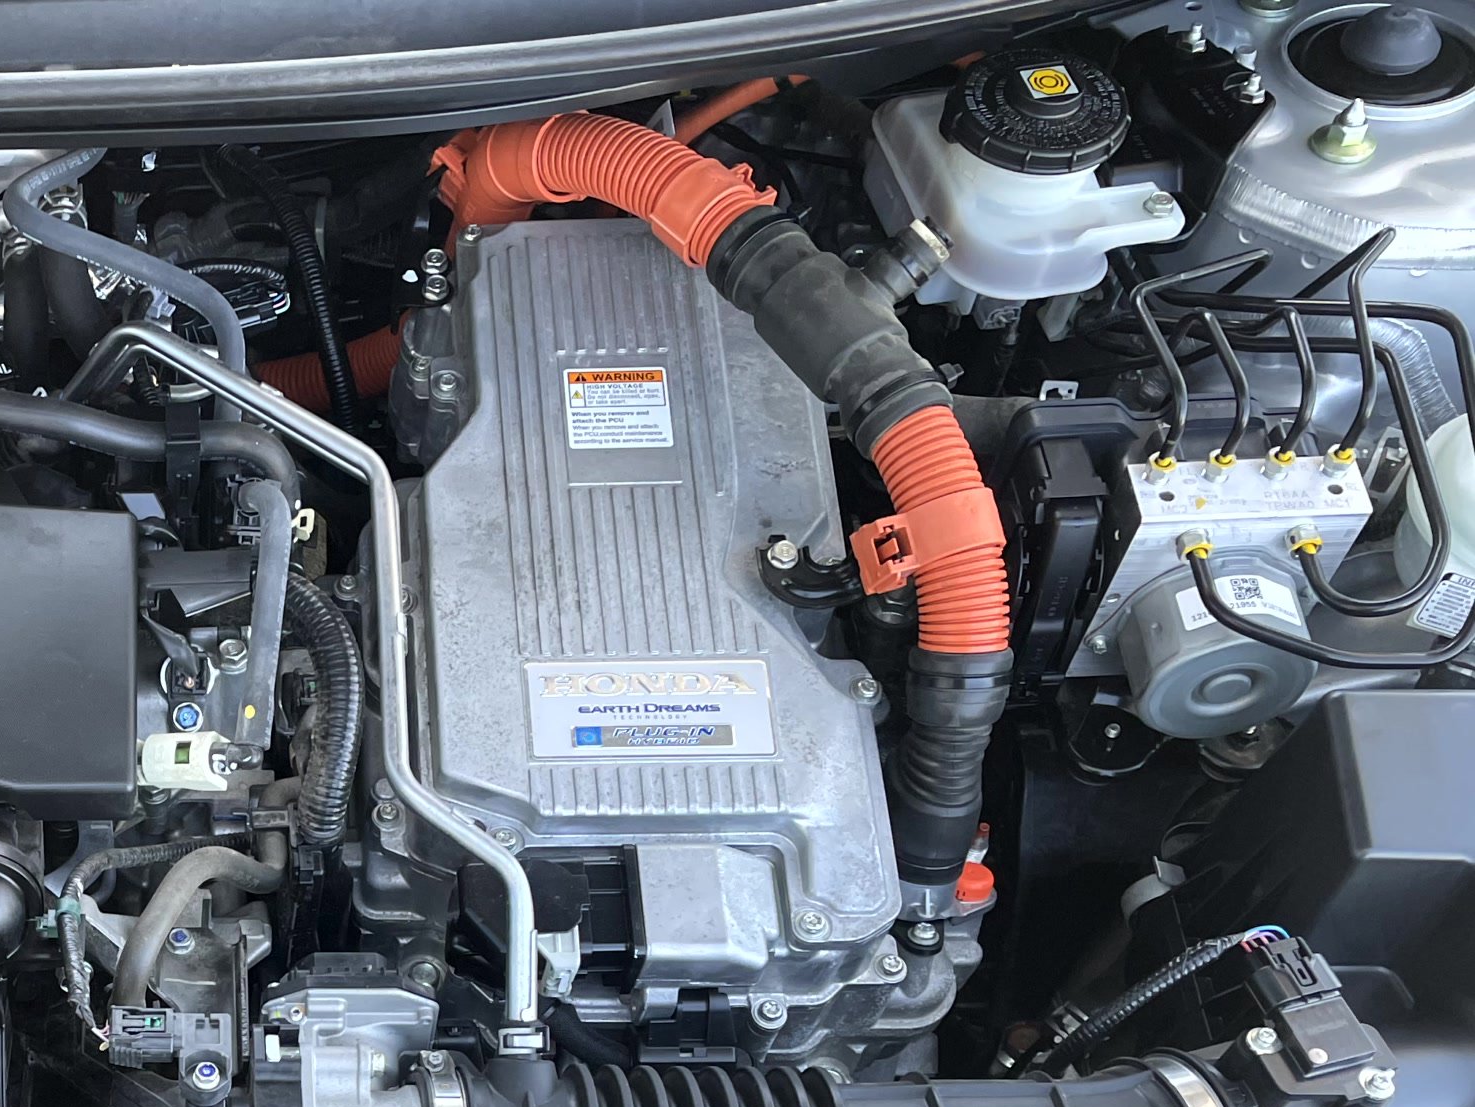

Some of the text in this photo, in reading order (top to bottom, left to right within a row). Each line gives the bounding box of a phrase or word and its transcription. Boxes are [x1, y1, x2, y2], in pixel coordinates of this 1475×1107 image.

[592, 373, 655, 381] WARNING
[539, 672, 757, 697] HONDA
[578, 702, 721, 714] EARTH DREAMS
[612, 726, 715, 737] PLUG-IN
[627, 737, 700, 745] HYBRID
